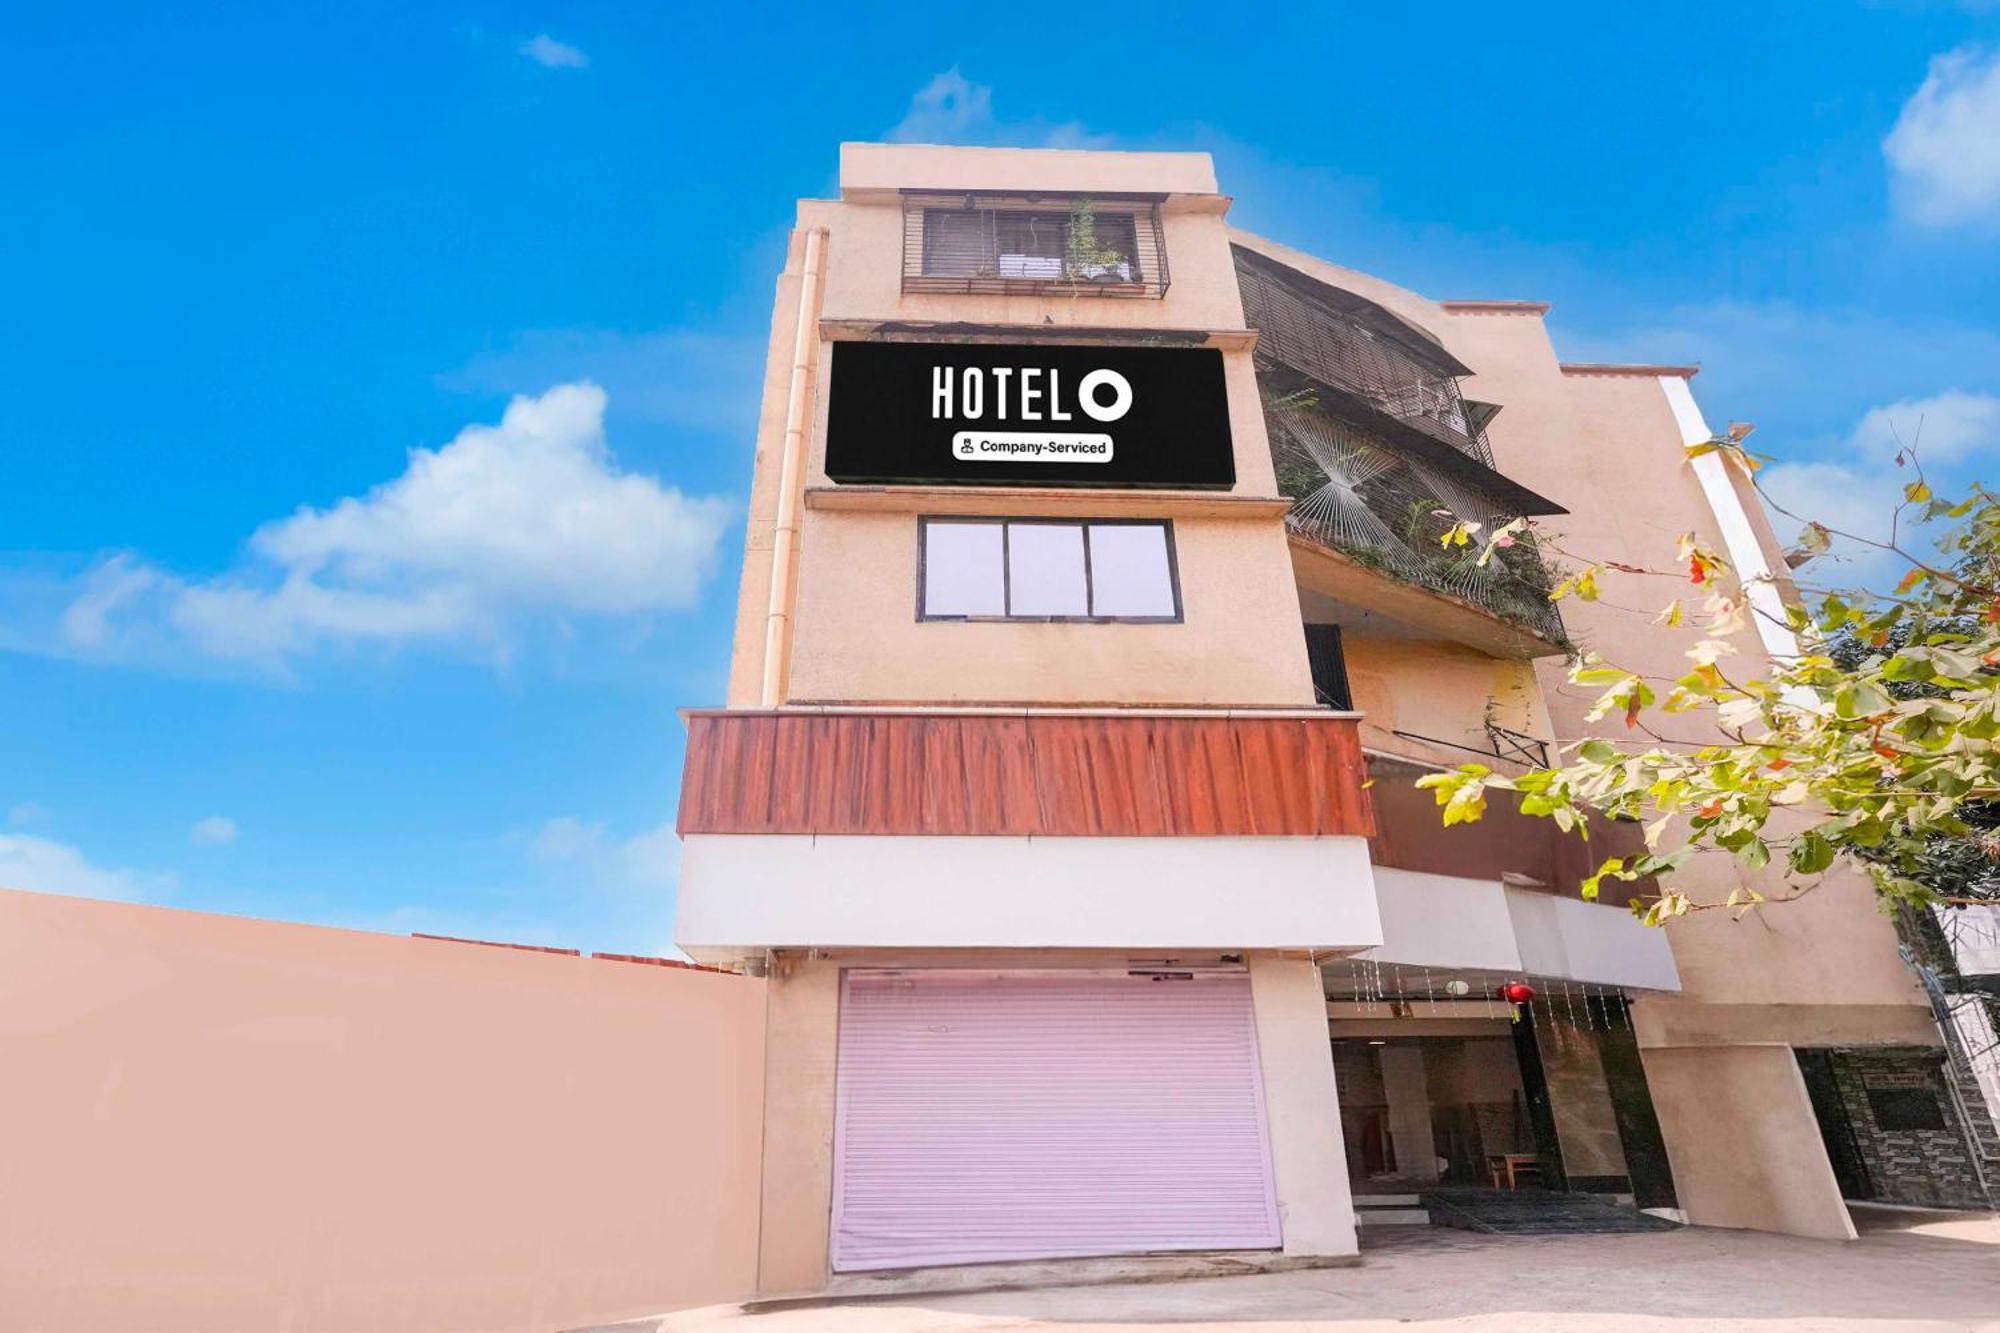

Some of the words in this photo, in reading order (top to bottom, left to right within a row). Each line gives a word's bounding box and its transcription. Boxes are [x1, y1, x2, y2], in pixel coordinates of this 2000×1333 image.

[932, 366, 1071, 421] HOTEL
[1078, 368, 1133, 422] O
[980, 440, 1107, 456] Company-Serviced
